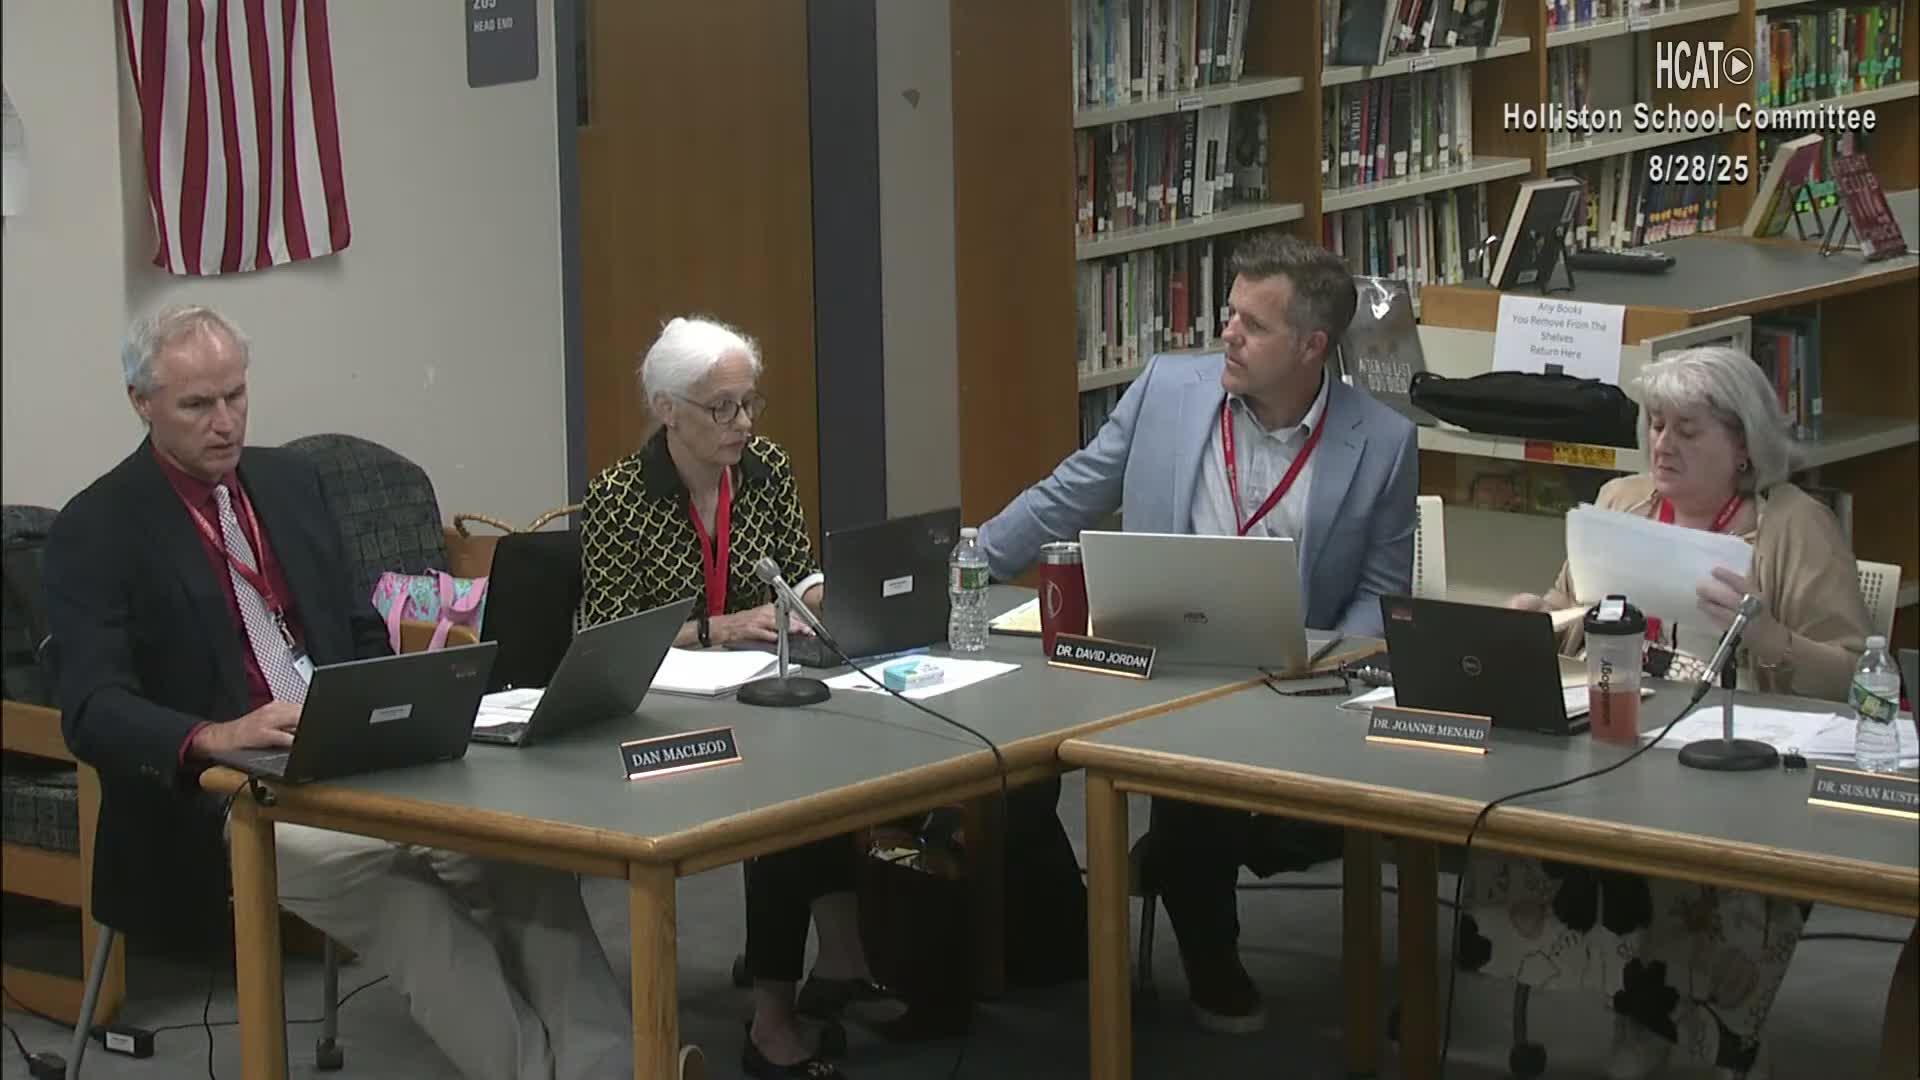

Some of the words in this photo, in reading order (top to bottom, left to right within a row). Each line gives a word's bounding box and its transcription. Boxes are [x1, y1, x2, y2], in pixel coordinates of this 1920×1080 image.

[473, 20, 496, 32] HEAD
[497, 17, 513, 30] END
[1537, 303, 1555, 314] Any
[1557, 304, 1583, 315] Books
[1513, 315, 1529, 325] You
[1531, 316, 1564, 328] Remove
[1567, 319, 1590, 329] From
[1592, 321, 1608, 331] The
[1541, 331, 1574, 343] Shelves
[1530, 344, 1560, 356] Return
[1561, 348, 1582, 359] Here
[1056, 644, 1074, 658] DR.
[1075, 647, 1106, 663] DAVID
[1107, 650, 1148, 669] JORDAN
[1373, 716, 1391, 731] DR.
[1392, 719, 1436, 737] JOANNE
[1437, 724, 1485, 741] MENARD
[632, 747, 660, 768] DAN
[662, 738, 728, 764] MACLEOD
[1817, 779, 1836, 793] DR.
[1839, 783, 1880, 800] SUSAN
